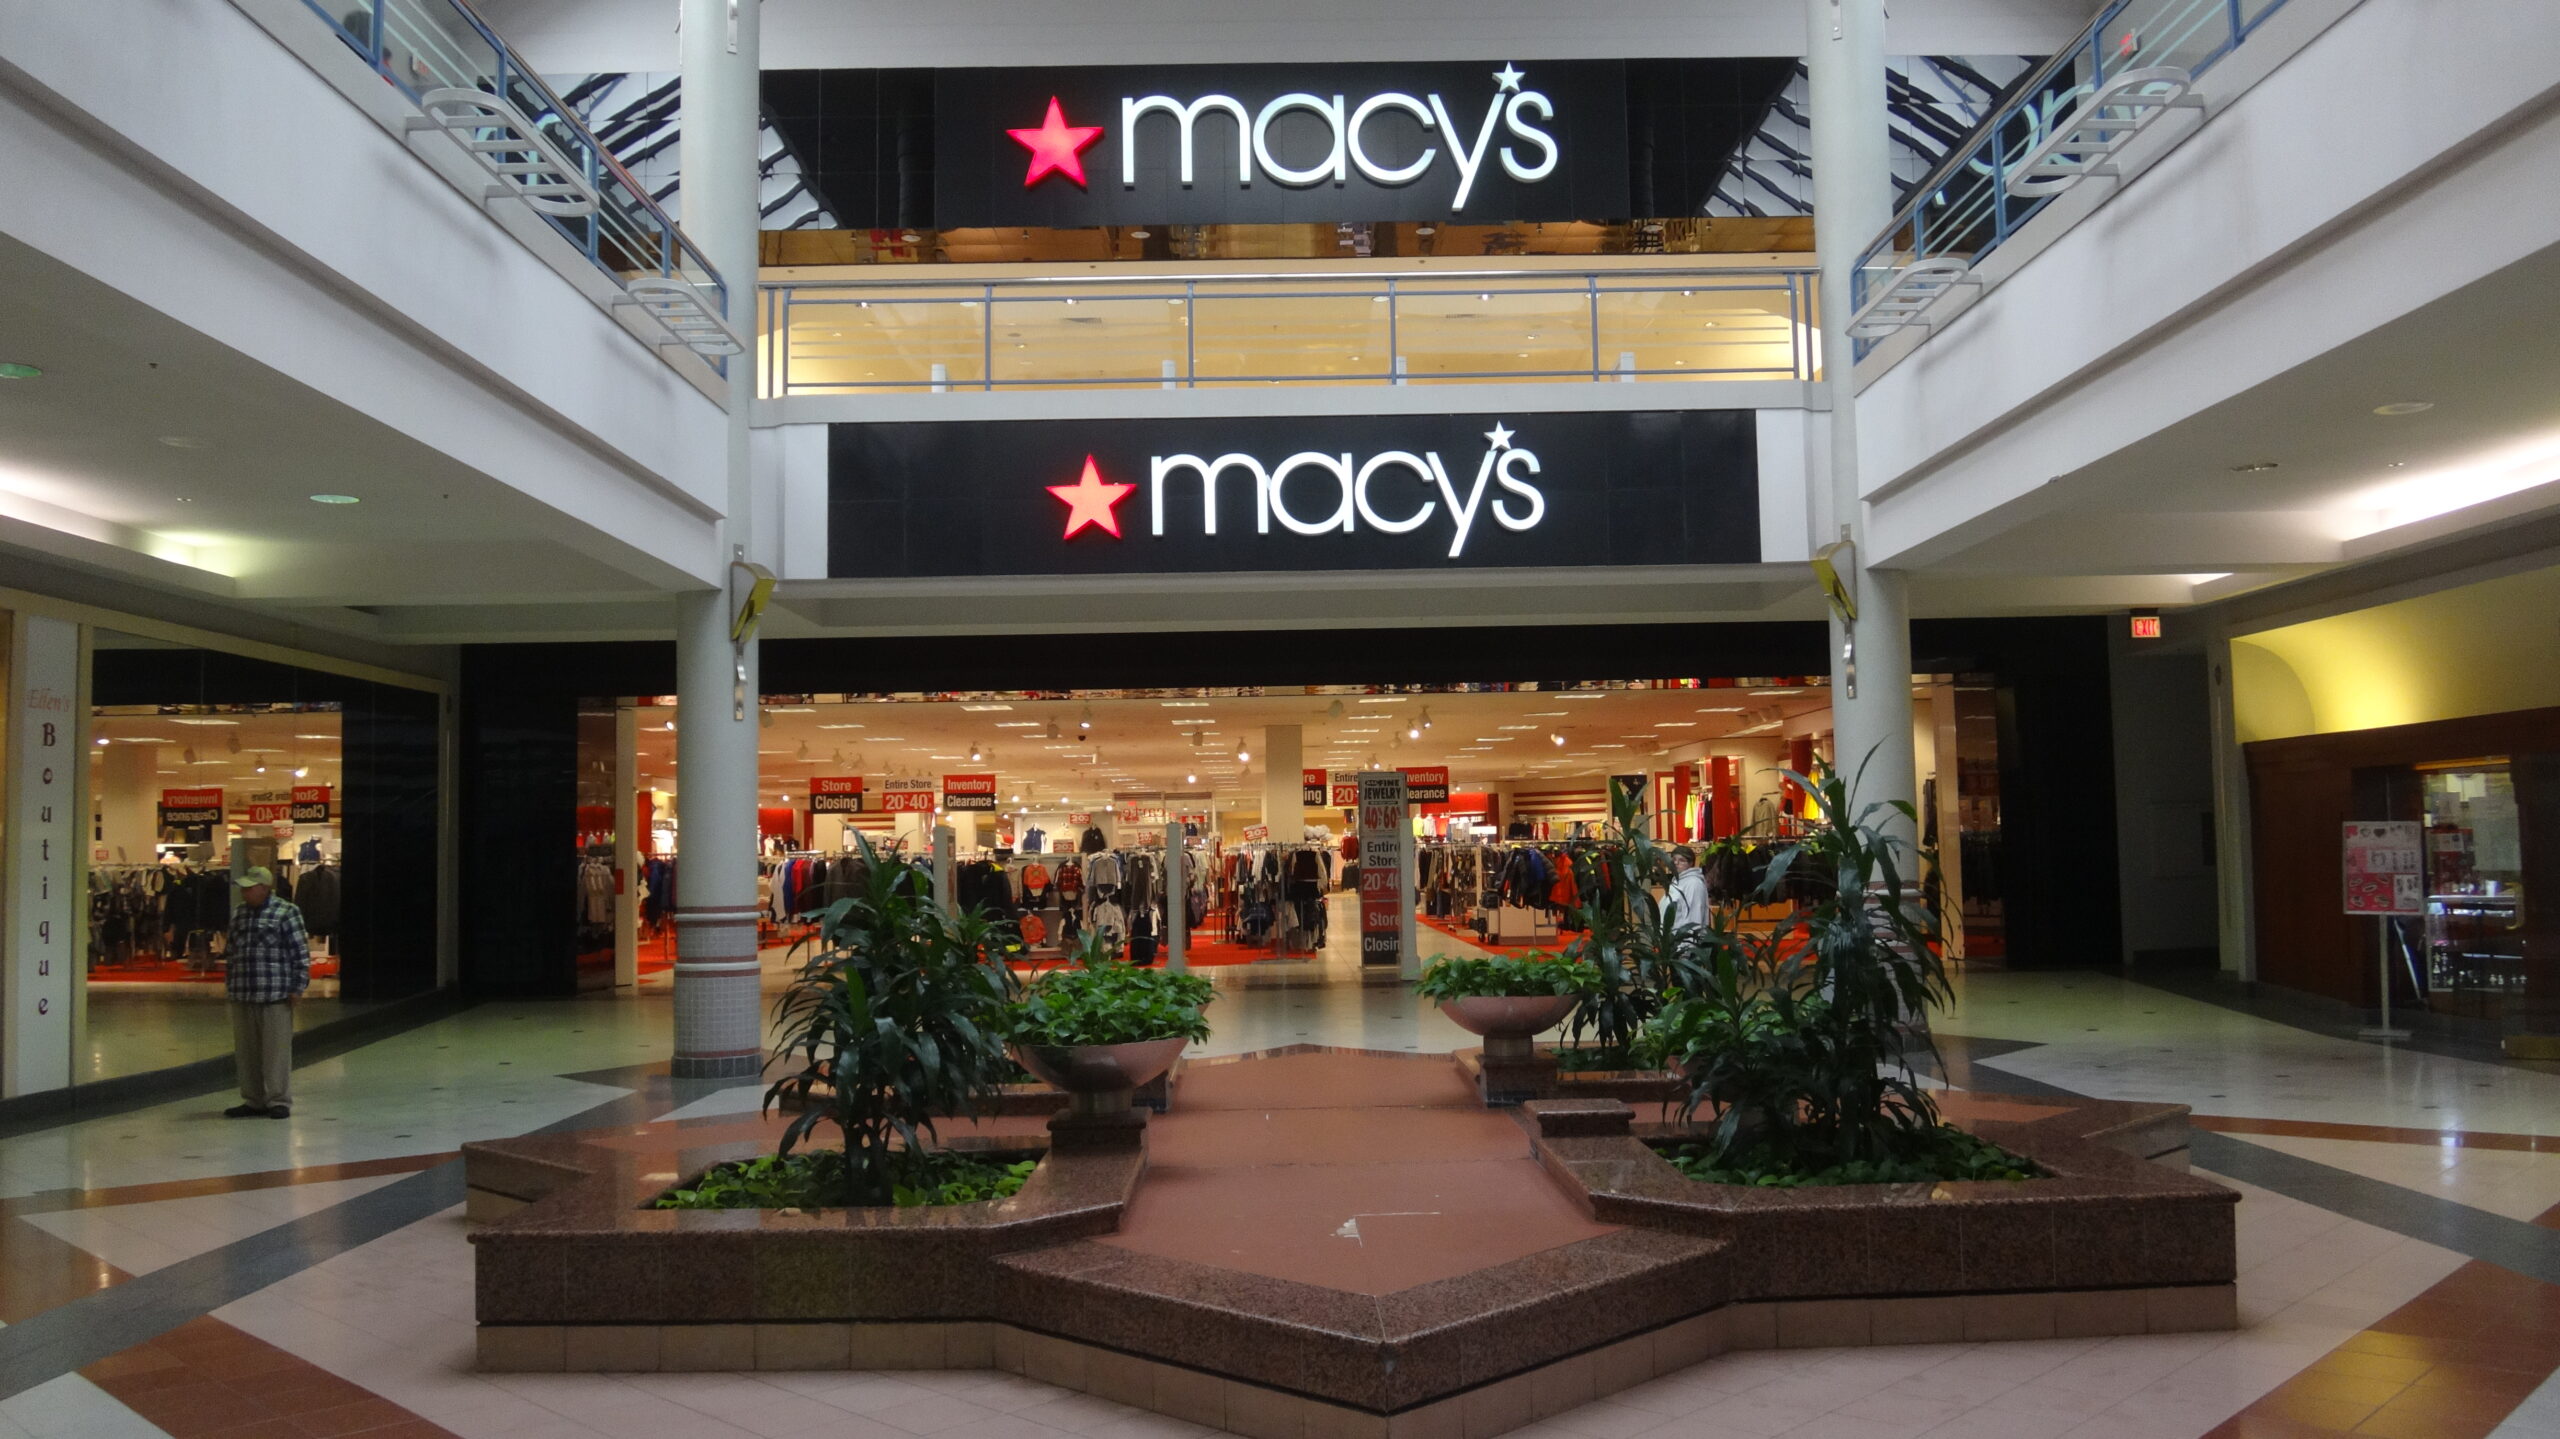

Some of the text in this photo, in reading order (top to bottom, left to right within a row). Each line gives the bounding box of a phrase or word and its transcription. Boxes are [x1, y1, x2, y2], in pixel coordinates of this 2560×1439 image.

[2134, 619, 2157, 636] EXIT
[885, 780, 931, 789] Entire Store
[1407, 772, 1444, 784] ventory
[821, 780, 851, 792] Store
[948, 779, 991, 792] Inventory
[1364, 787, 1401, 800] JEWELRY
[1407, 788, 1445, 799] learance
[815, 795, 858, 812] Closing
[947, 795, 992, 807] Clearance
[38, 722, 56, 1015] Boutique
[1364, 937, 1400, 951] Closin
